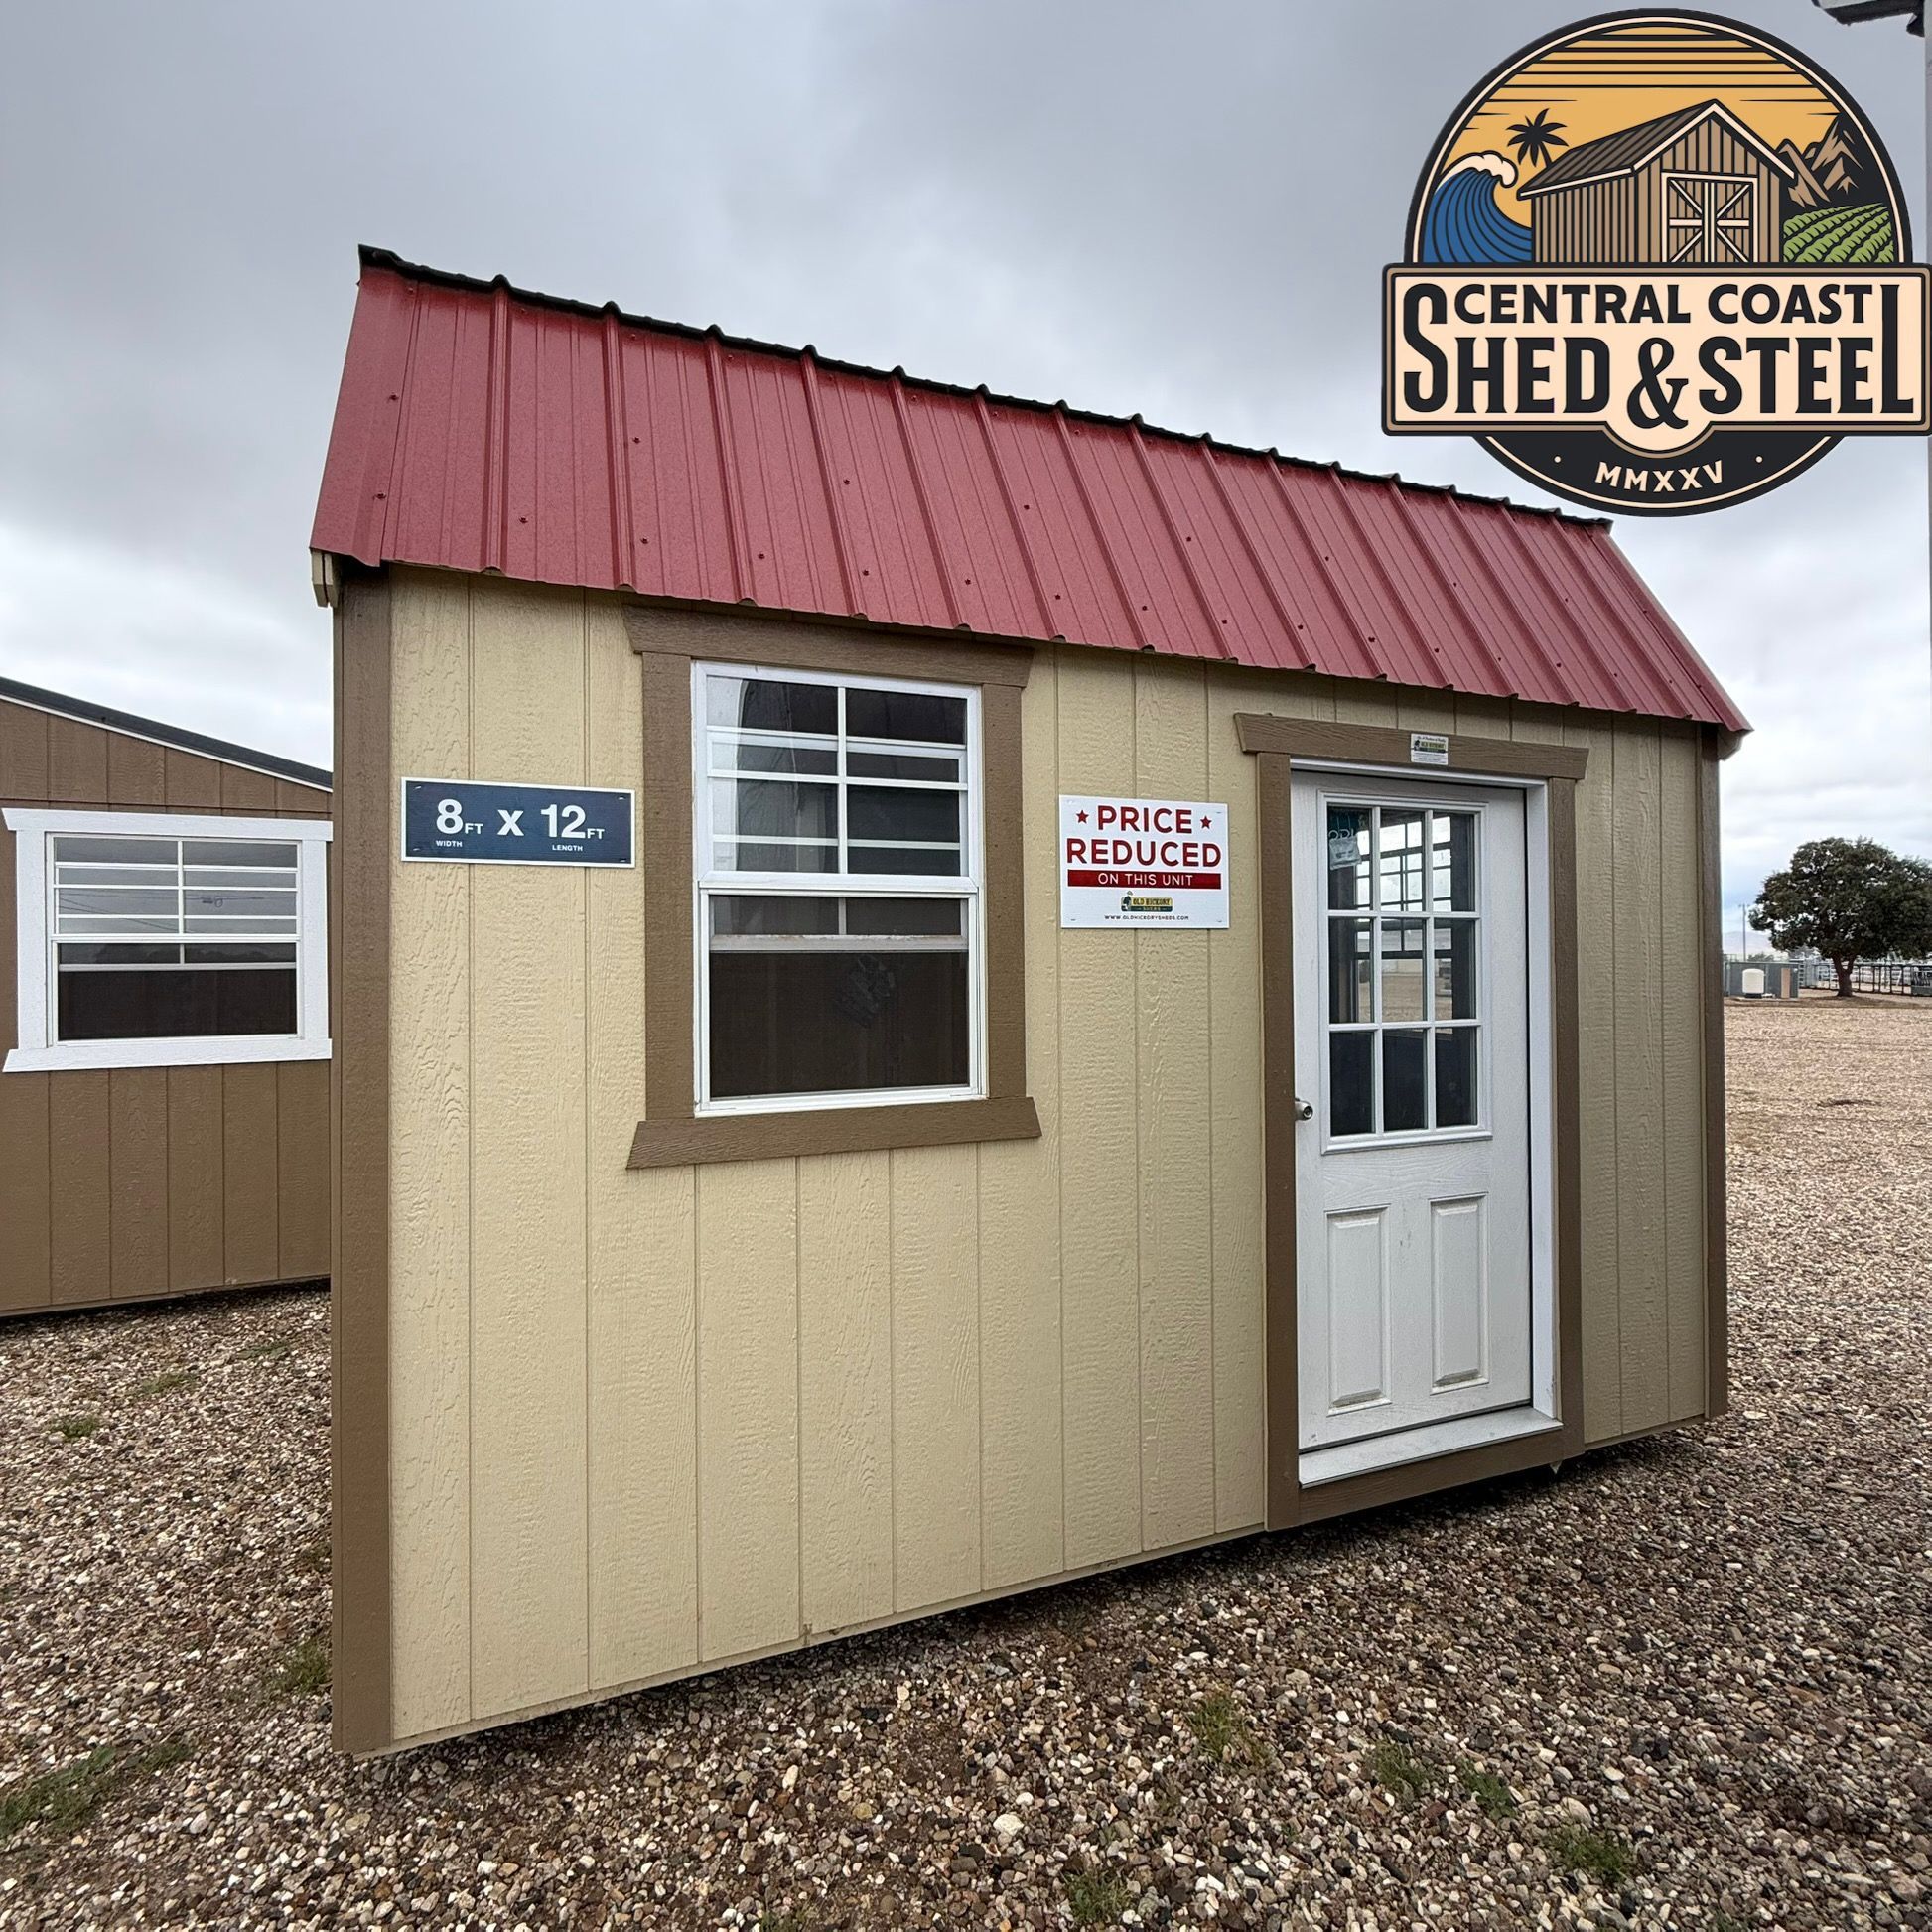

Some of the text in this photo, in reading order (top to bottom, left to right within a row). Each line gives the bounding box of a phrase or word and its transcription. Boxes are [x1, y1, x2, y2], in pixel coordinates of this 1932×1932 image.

[1097, 805, 1192, 834] PRICE
[1066, 838, 1222, 867] REDUCED
[1097, 872, 1193, 886] ON THIS UNIT
